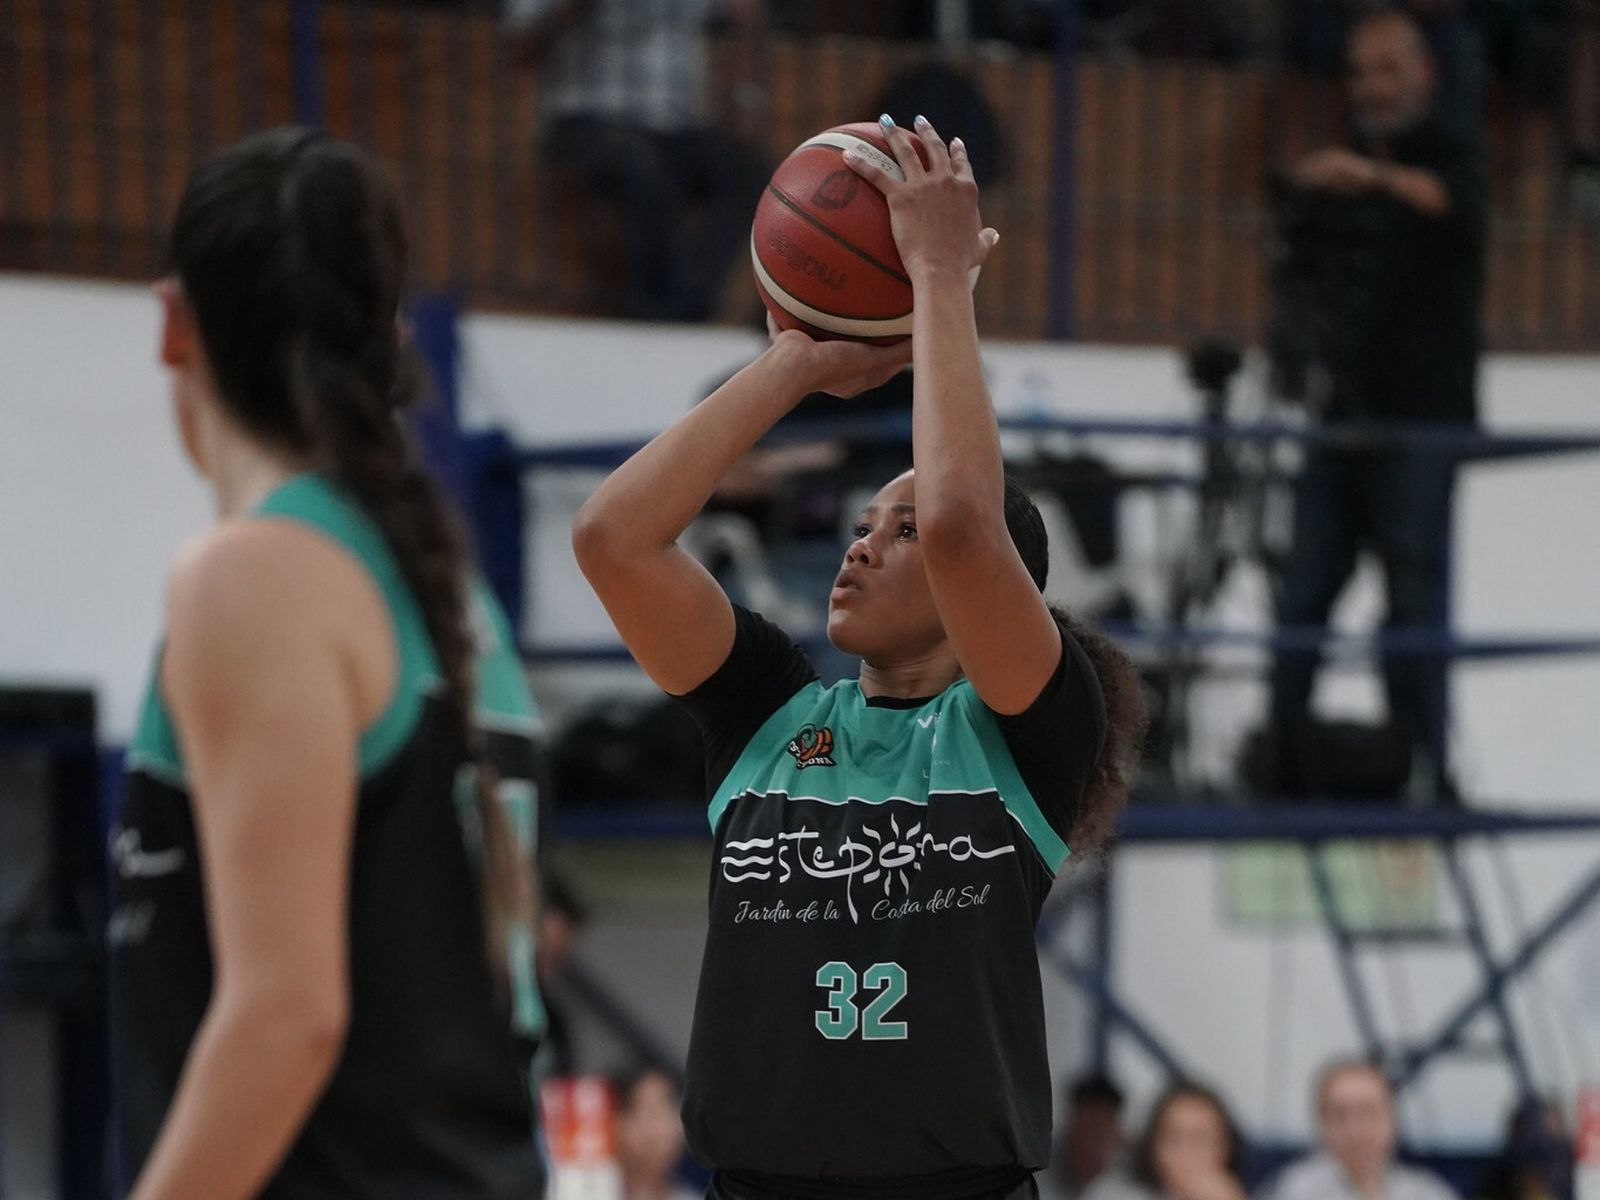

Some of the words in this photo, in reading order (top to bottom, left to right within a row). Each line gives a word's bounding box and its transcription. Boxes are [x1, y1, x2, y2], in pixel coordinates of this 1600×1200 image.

[796, 900, 820, 922] de
[823, 899, 841, 920] la
[926, 888, 956, 913] del
[957, 884, 991, 908] Sol
[815, 961, 908, 1040] 32
